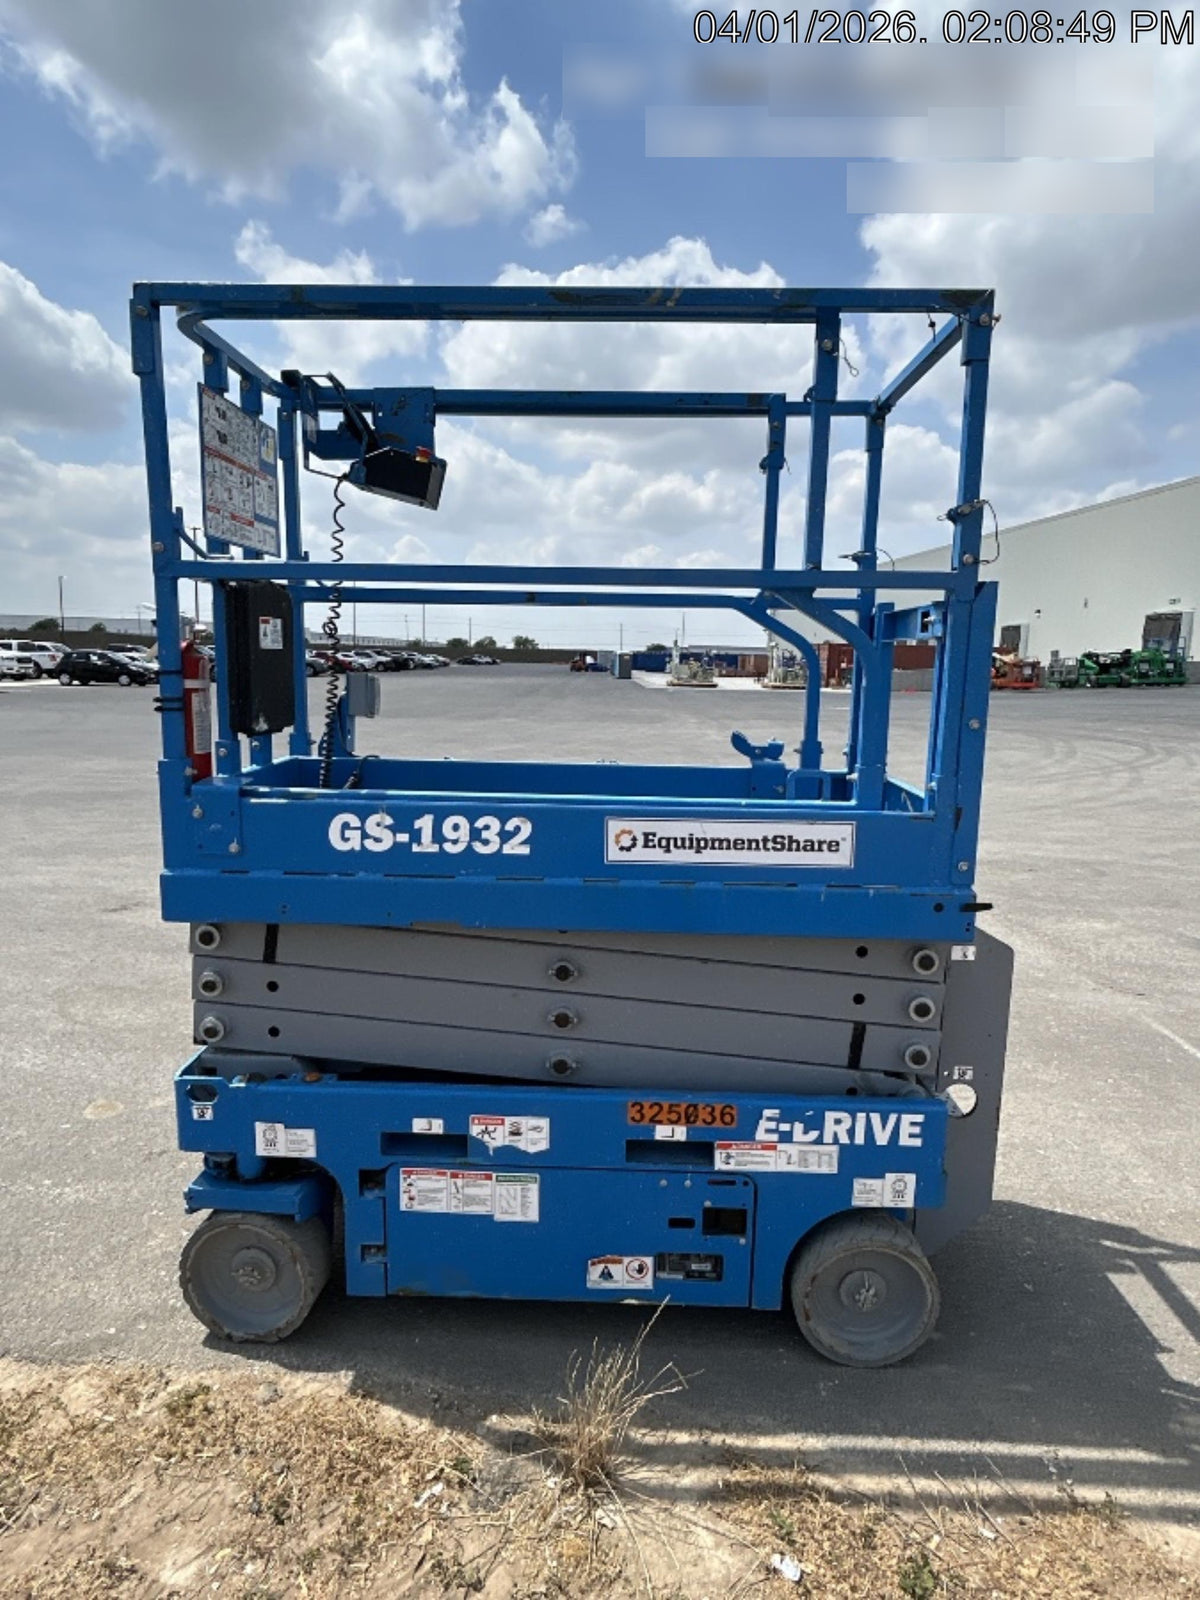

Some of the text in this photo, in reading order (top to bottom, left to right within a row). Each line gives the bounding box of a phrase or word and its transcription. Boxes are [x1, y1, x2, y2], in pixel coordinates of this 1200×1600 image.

[328, 812, 533, 855] GS-1932
[641, 831, 840, 854] EquipmentShare
[630, 1101, 736, 1126] 325036
